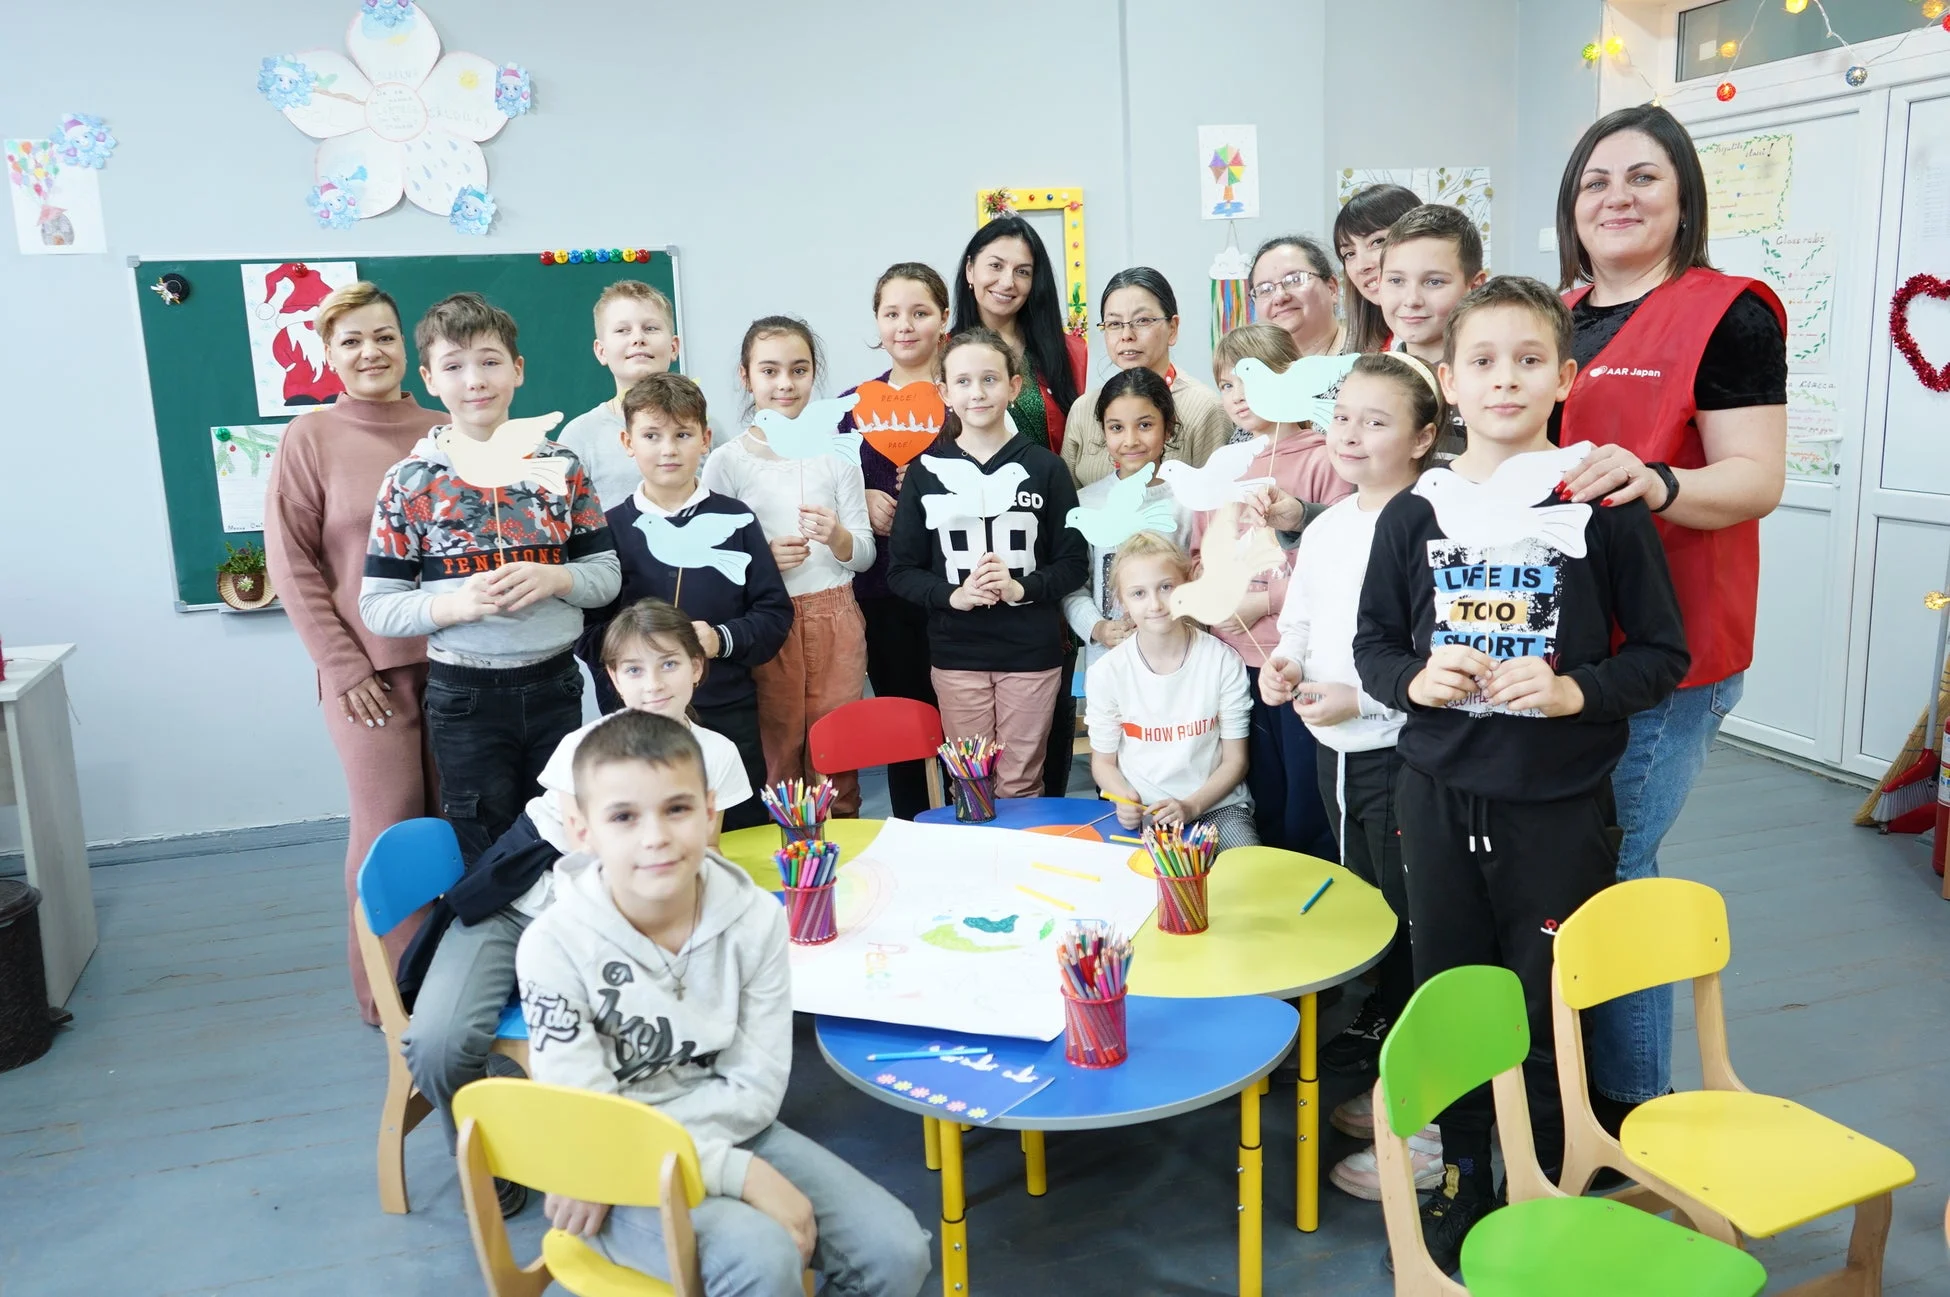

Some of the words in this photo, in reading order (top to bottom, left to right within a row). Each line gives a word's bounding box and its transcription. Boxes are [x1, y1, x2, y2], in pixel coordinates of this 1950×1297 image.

[1606, 367, 1629, 376] AAR
[1630, 367, 1661, 378] Japan
[443, 548, 561, 575] TENSIONS
[1445, 566, 1501, 590] LIFE
[1512, 567, 1541, 589] IS
[1458, 602, 1516, 622] TOO
[1444, 635, 1536, 657] SHORT
[1145, 727, 1173, 742] HOW
